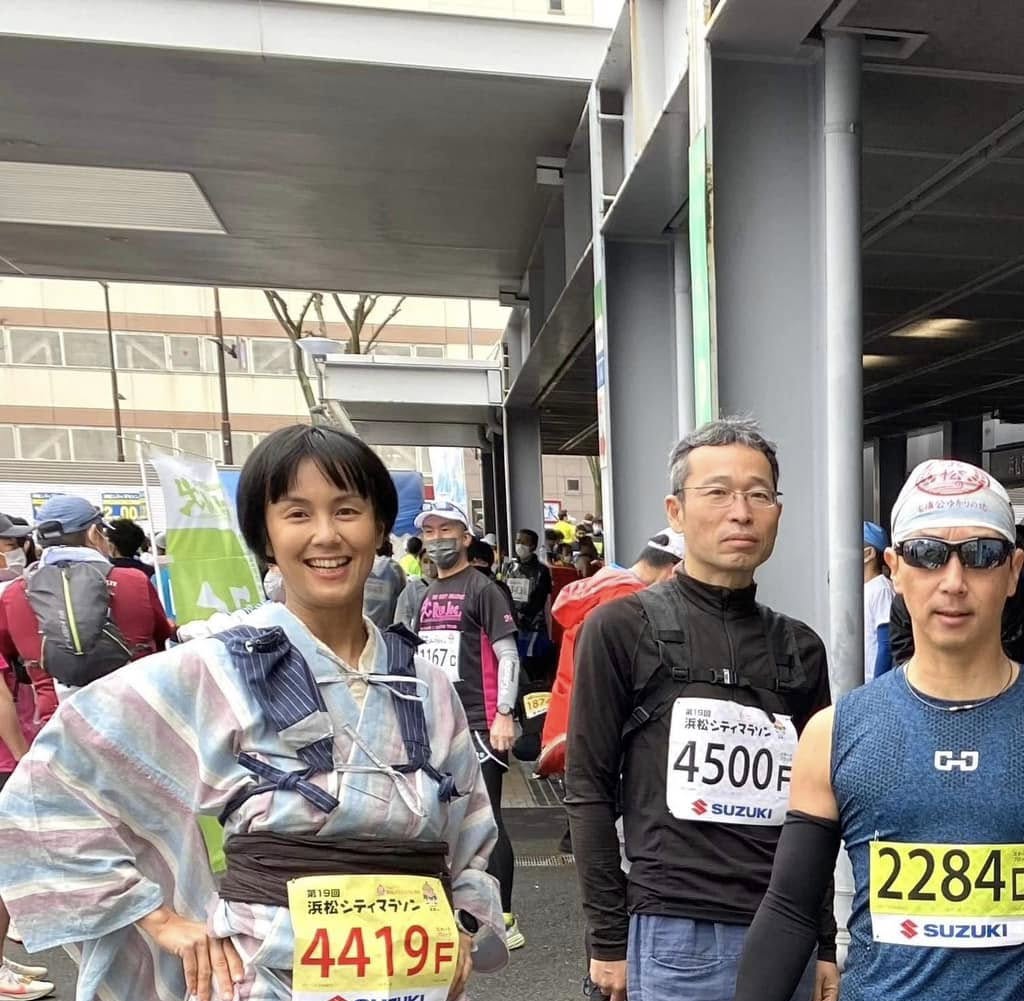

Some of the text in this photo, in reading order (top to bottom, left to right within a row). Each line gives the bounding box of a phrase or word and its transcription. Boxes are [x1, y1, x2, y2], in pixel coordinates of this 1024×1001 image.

[685, 717, 771, 737] 浜松シティマラソン
[712, 803, 772, 819] SUZUKI
[307, 889, 340, 898] 第19回
[308, 899, 421, 915] 浜松シティマラソン
[923, 923, 1008, 938] SUZUKI
